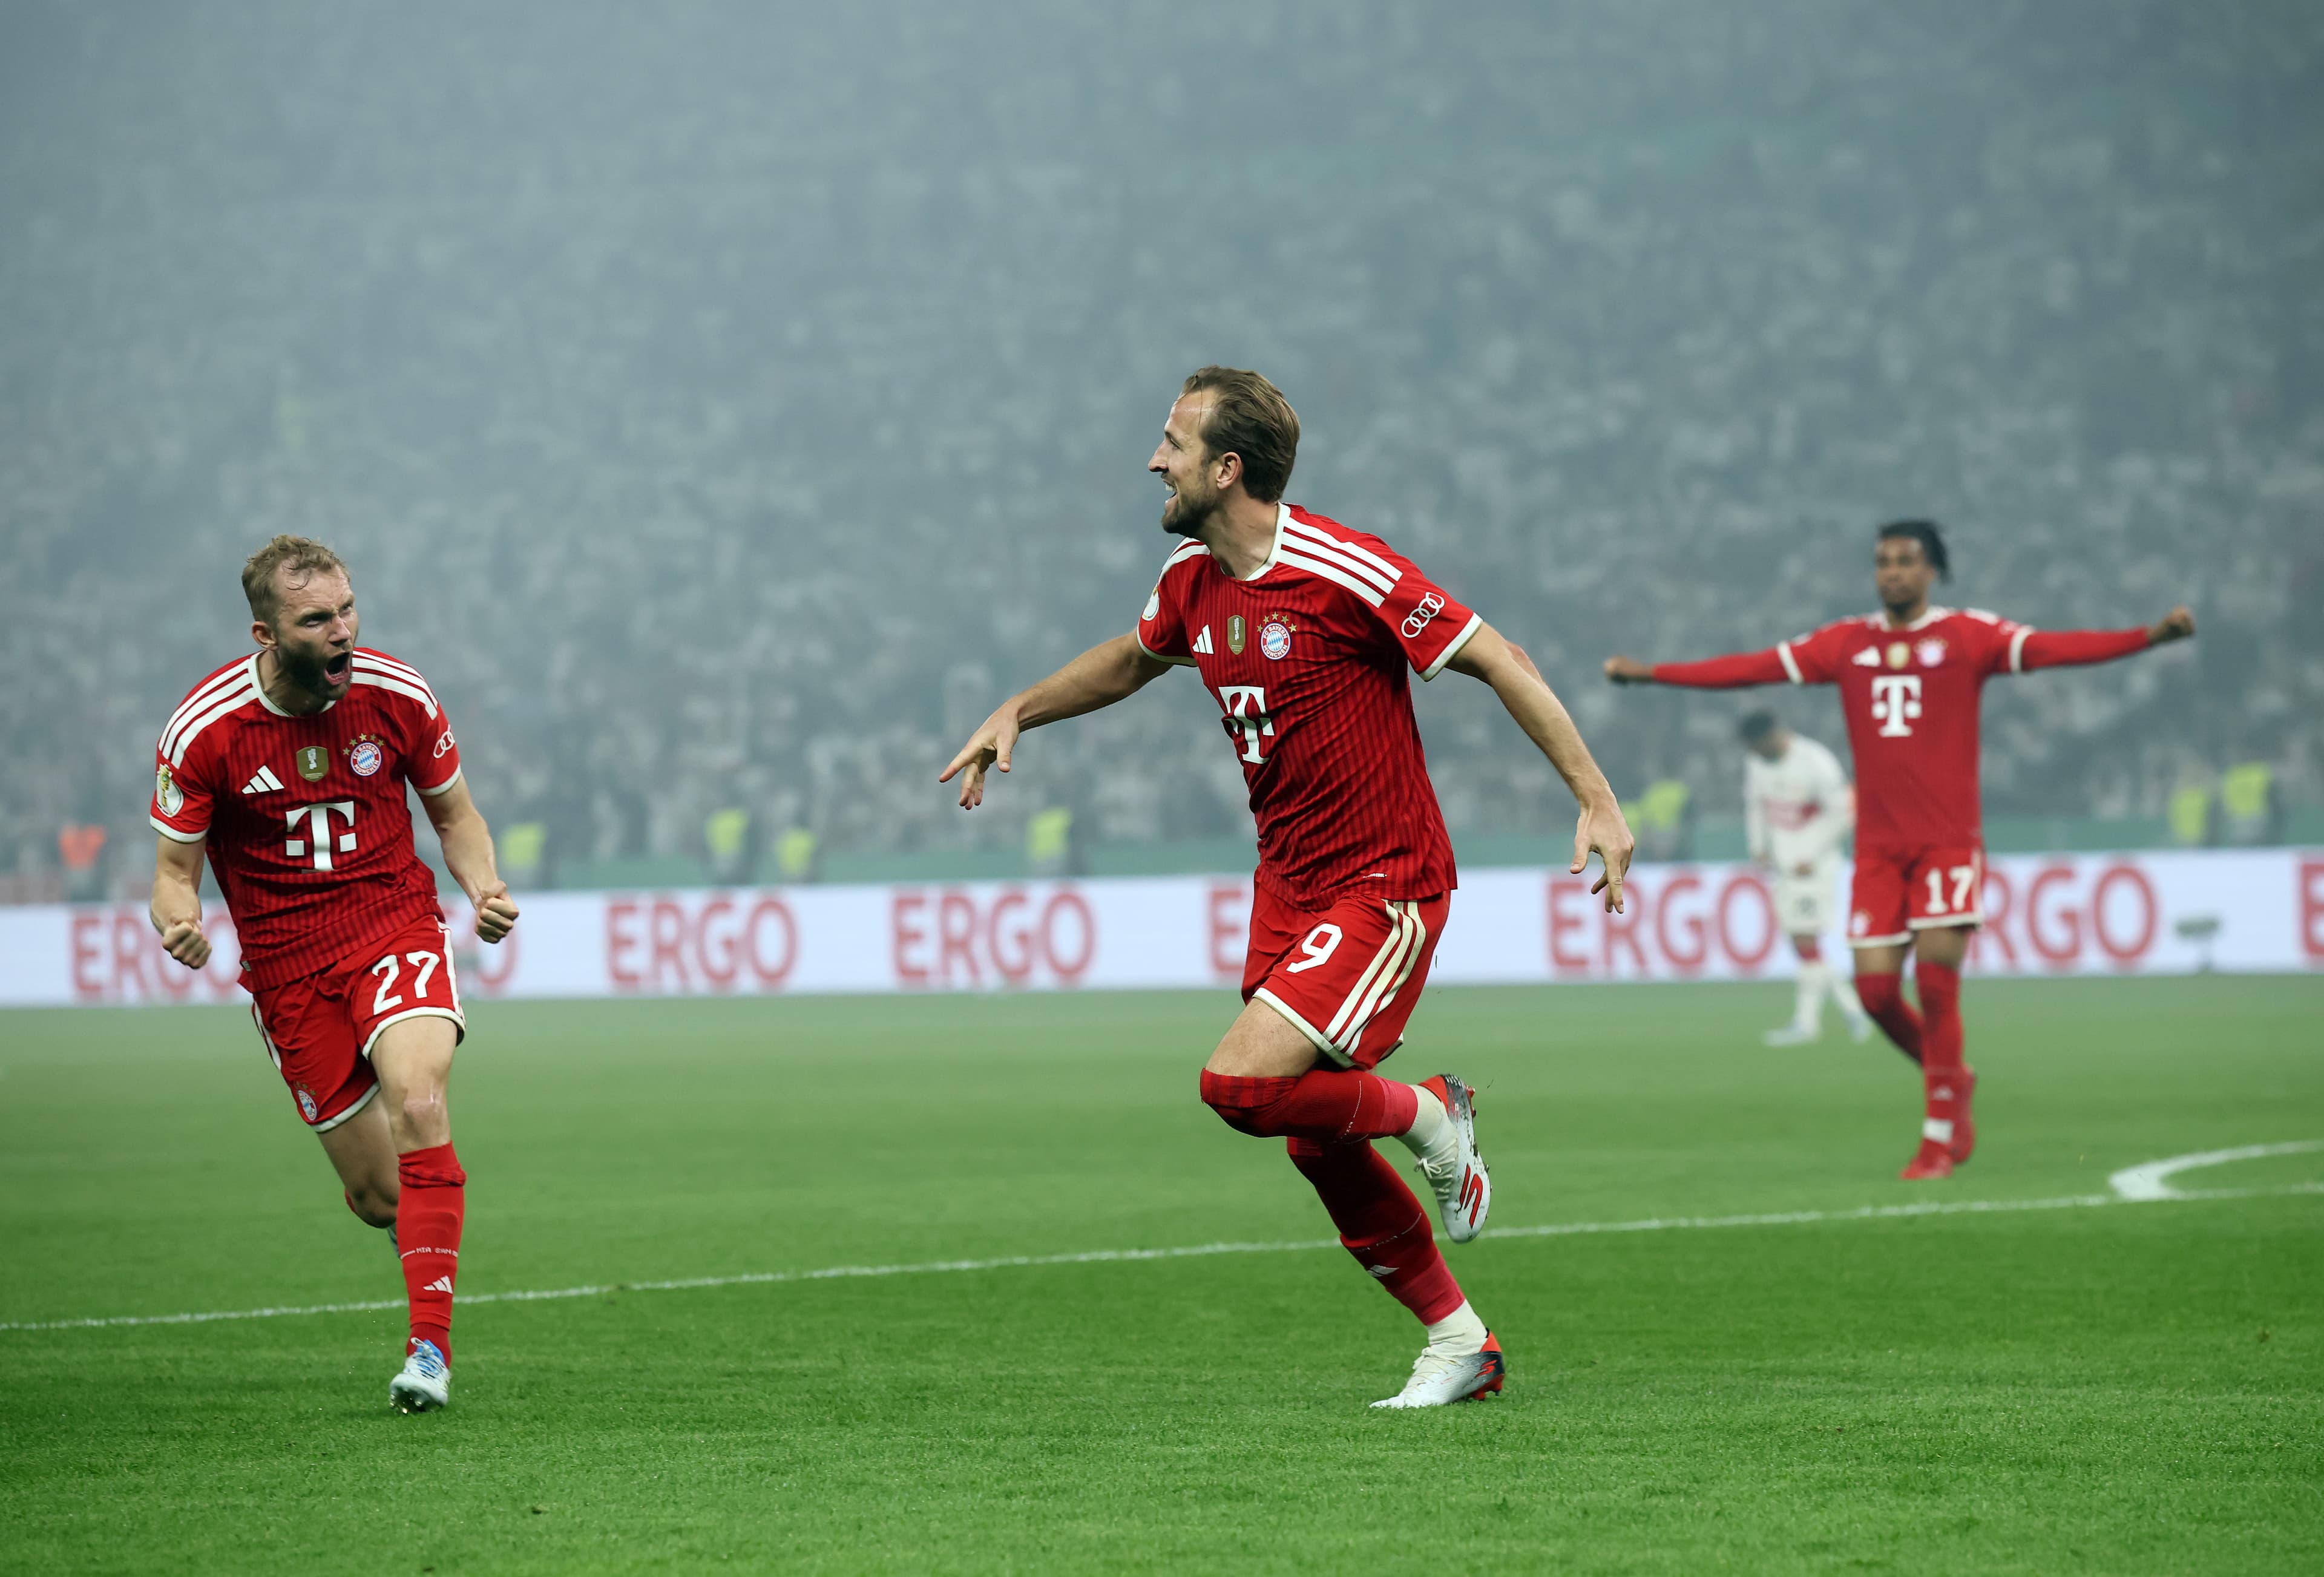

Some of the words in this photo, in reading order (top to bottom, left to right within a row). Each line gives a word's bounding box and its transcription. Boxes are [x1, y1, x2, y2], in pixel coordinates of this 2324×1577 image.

[1268, 625, 1288, 639] BAYERN
[1218, 686, 1275, 764] T
[1871, 675, 1922, 737] T
[285, 801, 357, 871] T
[1548, 874, 1778, 969] ERGO
[1925, 865, 1974, 914] 17
[1972, 865, 2157, 962] RGO
[605, 898, 798, 987] ERGO
[892, 891, 1097, 982] ERGO
[1285, 923, 1343, 974] 9
[371, 949, 441, 1016] 27
[435, 1247, 451, 1255] SAN
